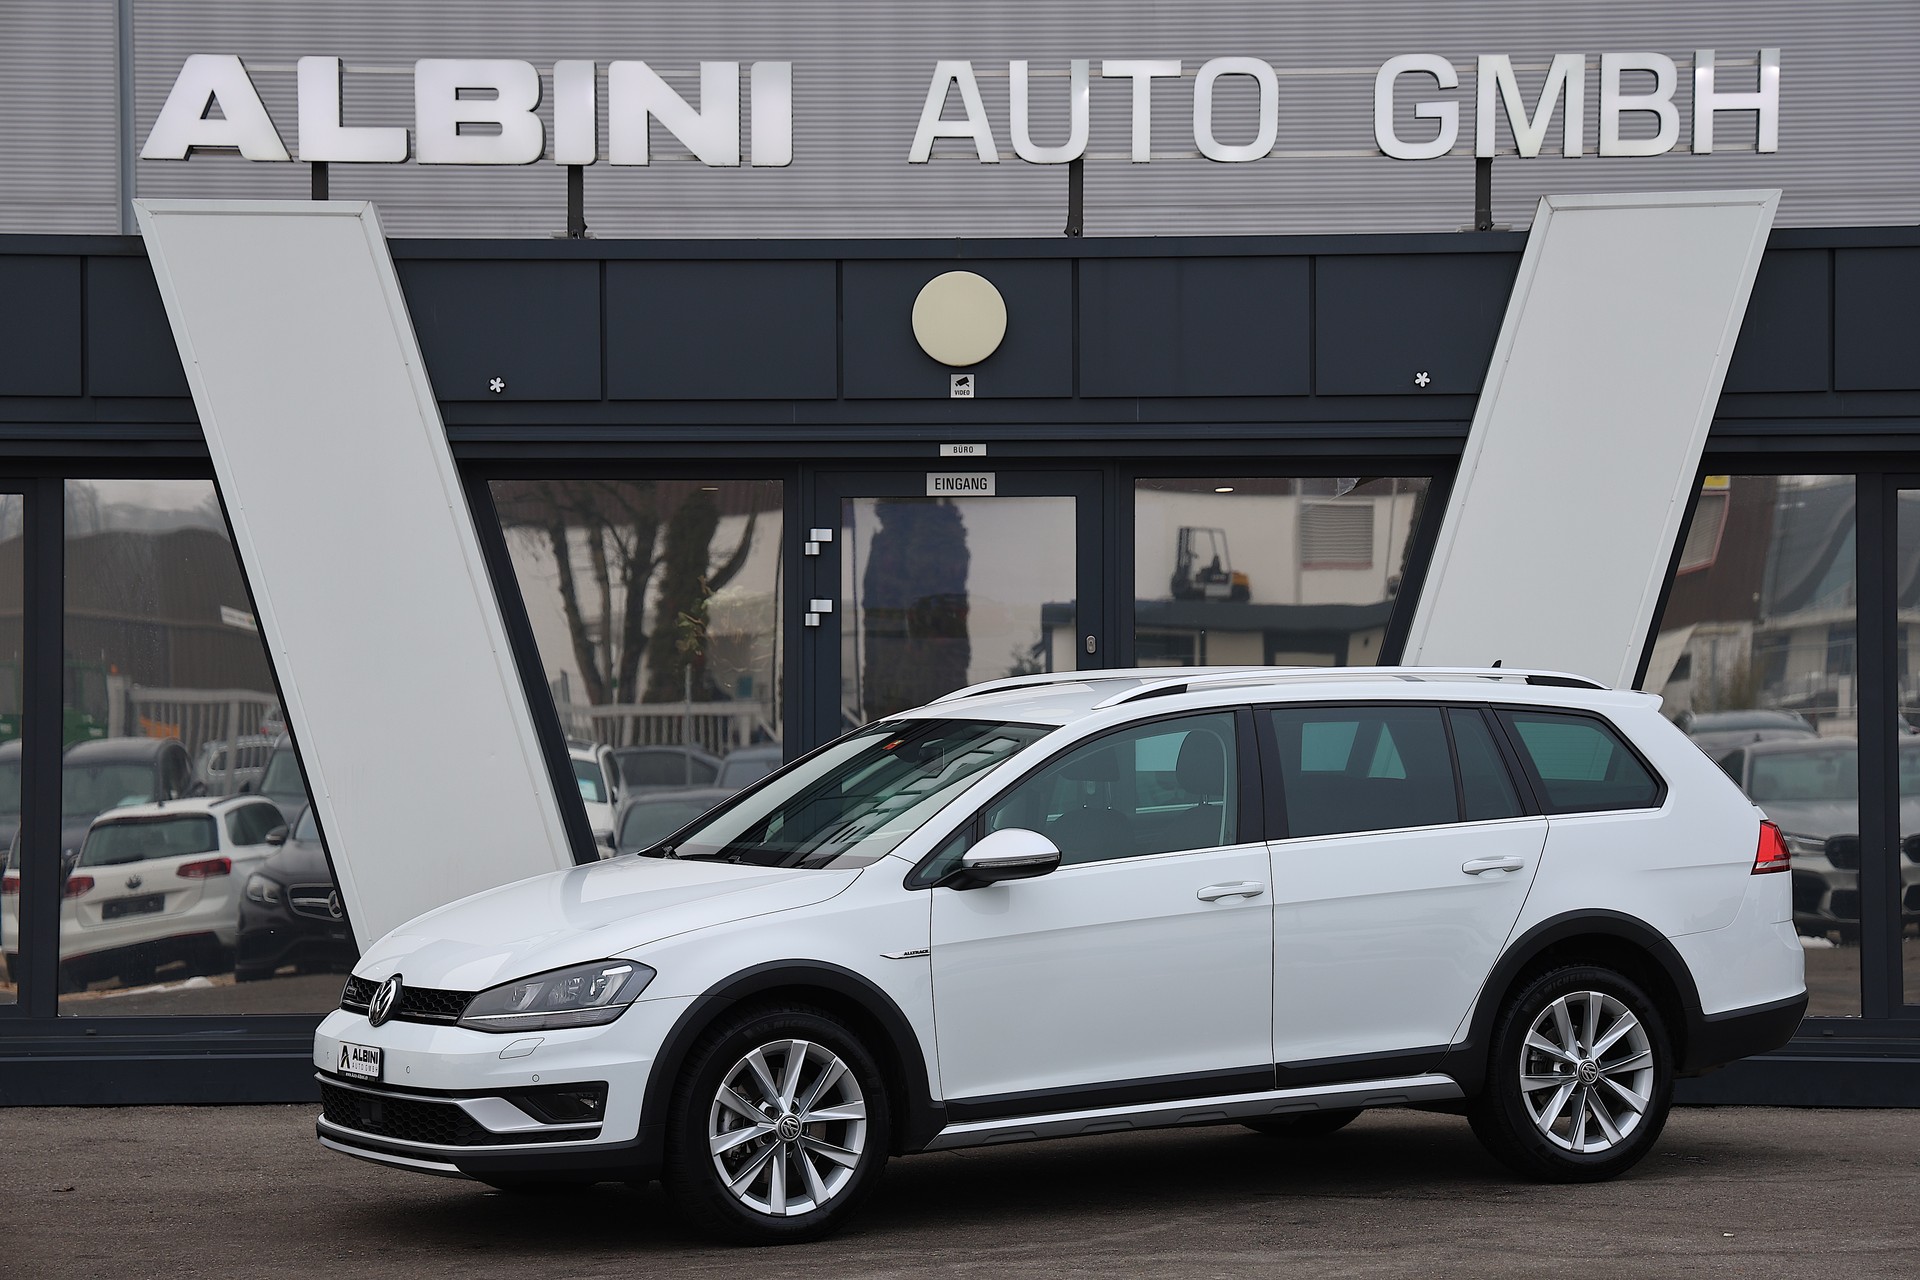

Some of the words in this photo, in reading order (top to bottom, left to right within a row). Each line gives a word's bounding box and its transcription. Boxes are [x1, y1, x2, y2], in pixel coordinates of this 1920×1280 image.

[140, 54, 794, 168] ALBINI
[908, 56, 1280, 165] AUTO
[1372, 48, 1781, 160] GMBH
[953, 445, 974, 454] BÜRO
[934, 477, 988, 490] EINGANG
[352, 1048, 379, 1065] ALBINI
